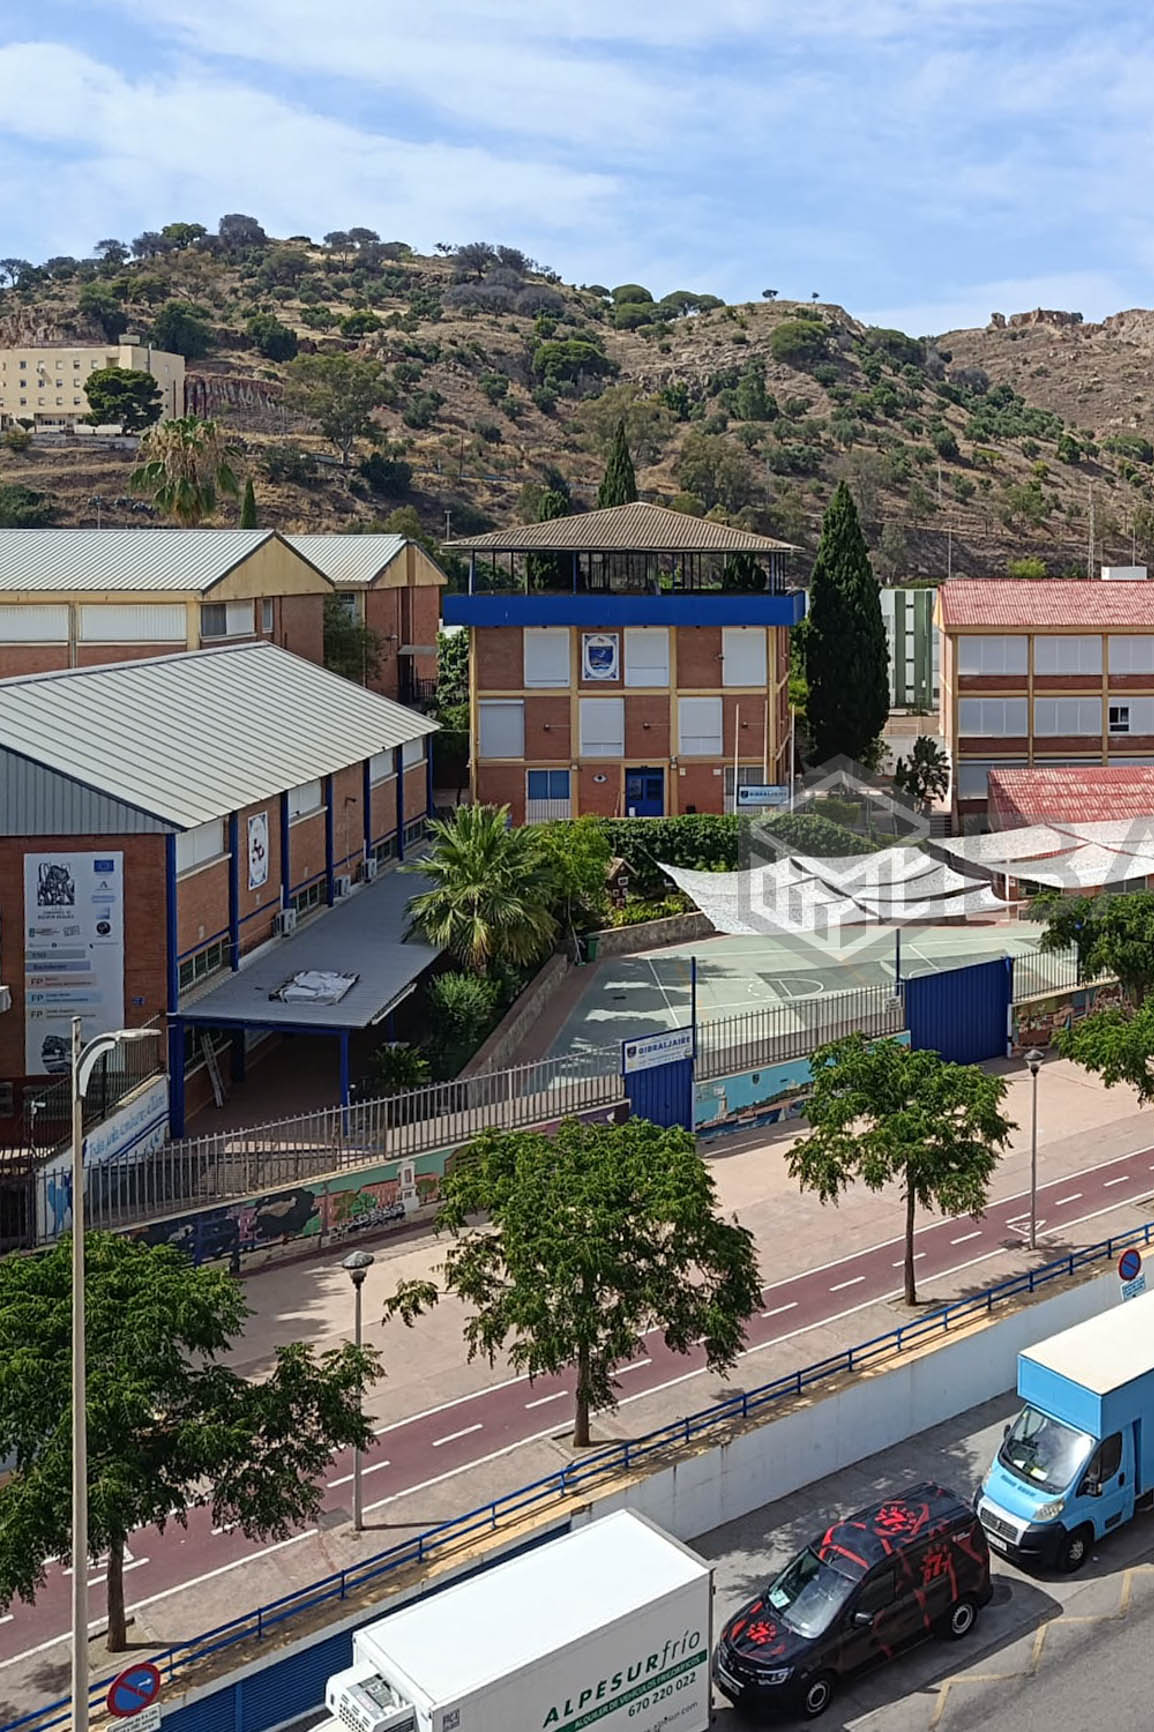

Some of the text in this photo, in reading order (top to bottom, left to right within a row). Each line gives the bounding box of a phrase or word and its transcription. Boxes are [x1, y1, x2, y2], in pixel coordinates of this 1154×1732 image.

[628, 1697, 649, 1717] 670
[652, 1685, 674, 1704] 220
[675, 1671, 697, 1688] 022
